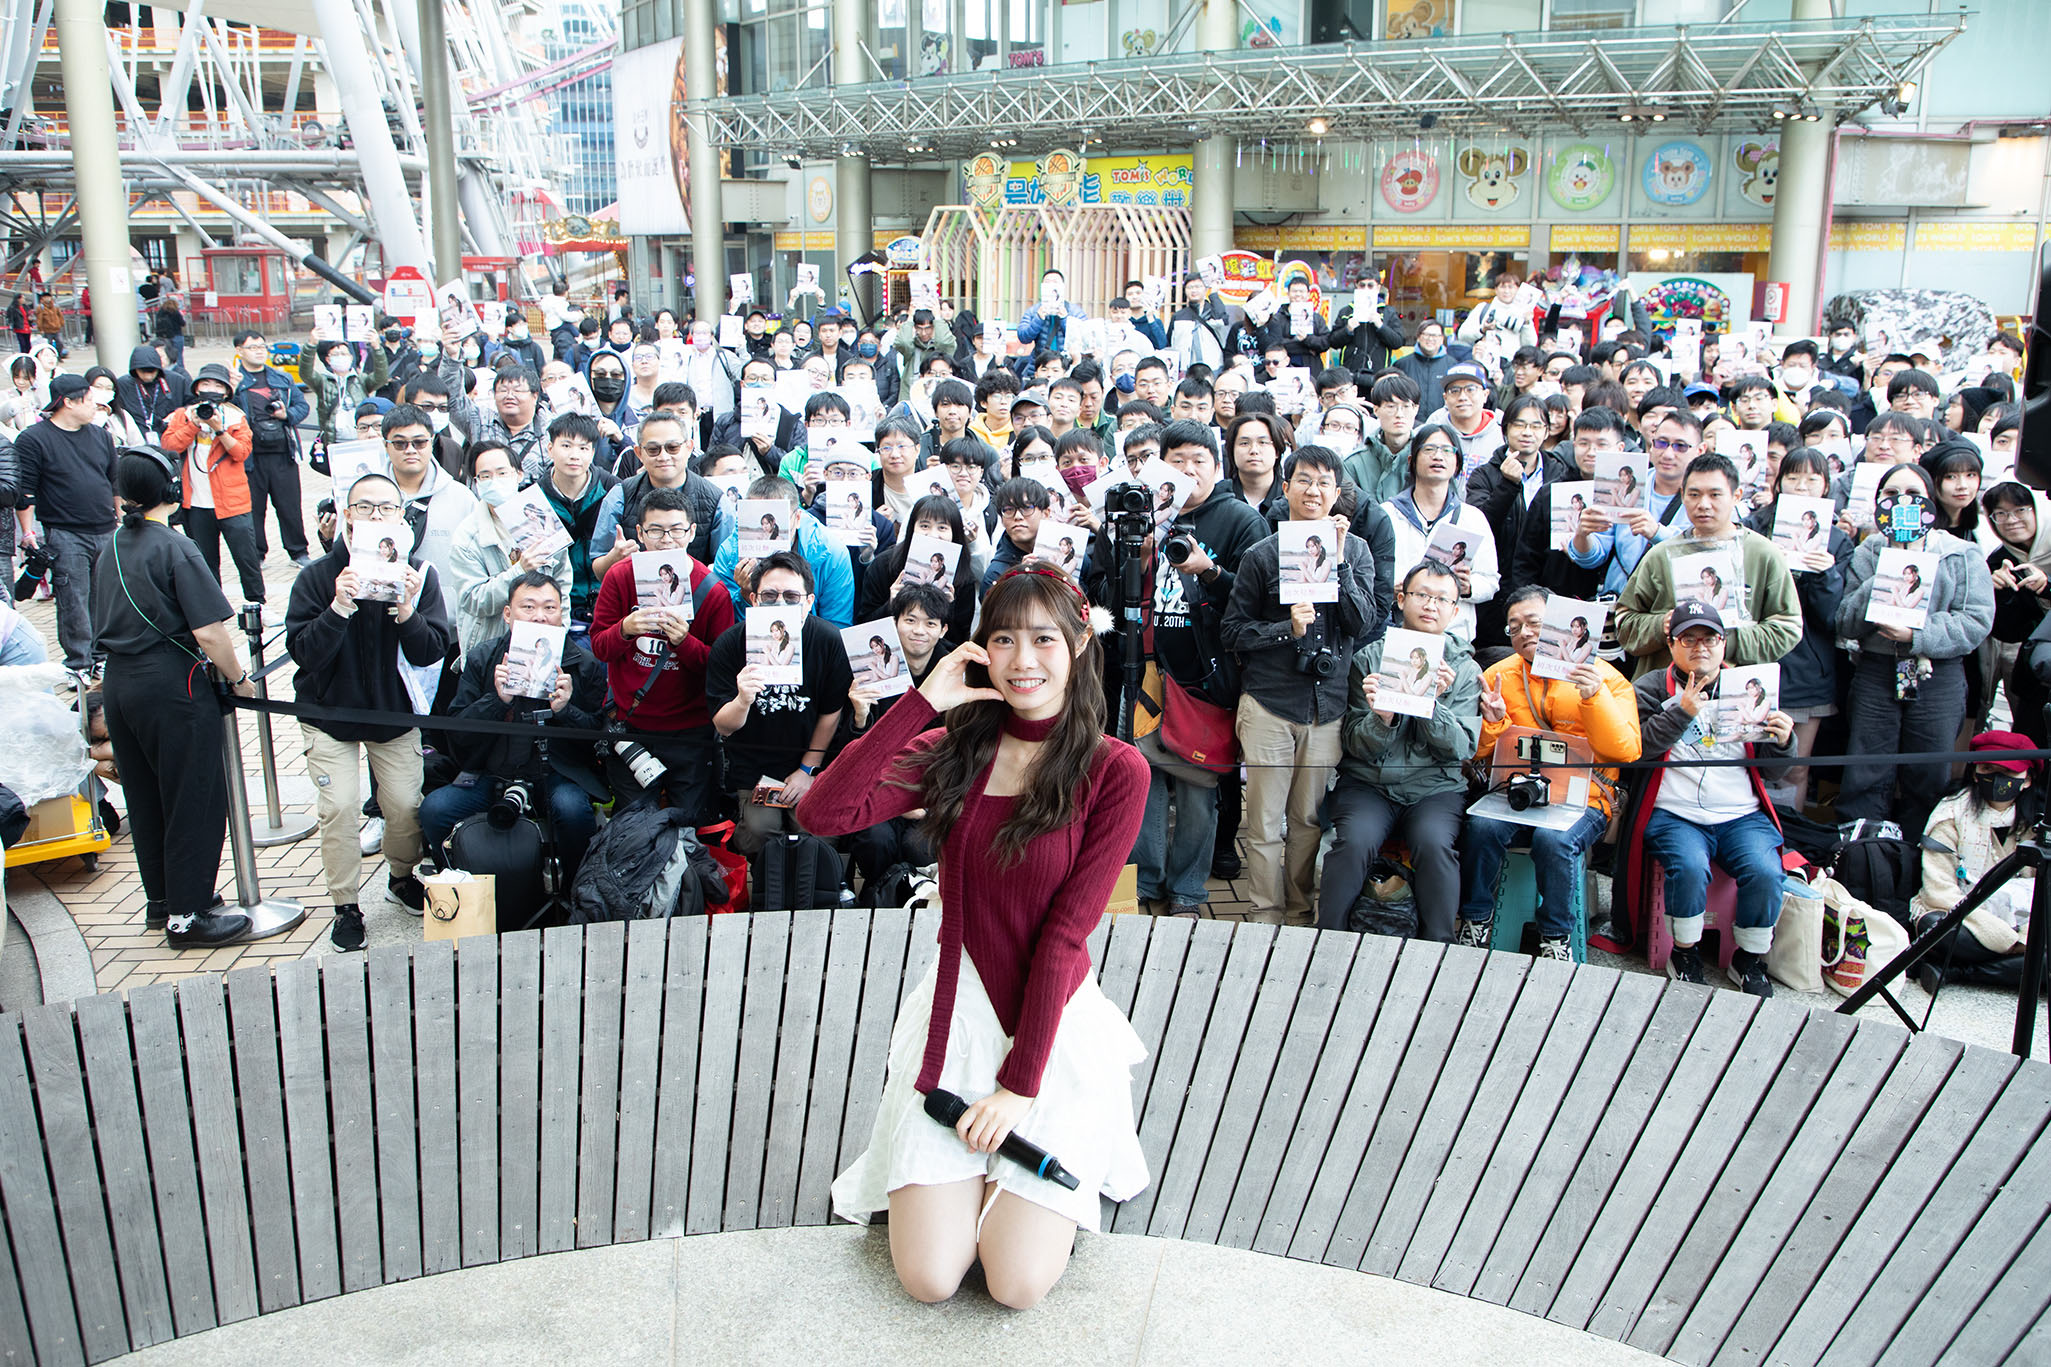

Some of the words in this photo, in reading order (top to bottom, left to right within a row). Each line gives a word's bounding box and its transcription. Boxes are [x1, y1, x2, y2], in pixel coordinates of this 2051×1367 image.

[1008, 51, 1044, 68] TOM'S
[1112, 168, 1152, 184] TOM'S
[1154, 167, 1193, 186] WORL
[1692, 234, 1721, 242] TOM'S
[1164, 615, 1185, 627] 20TH
